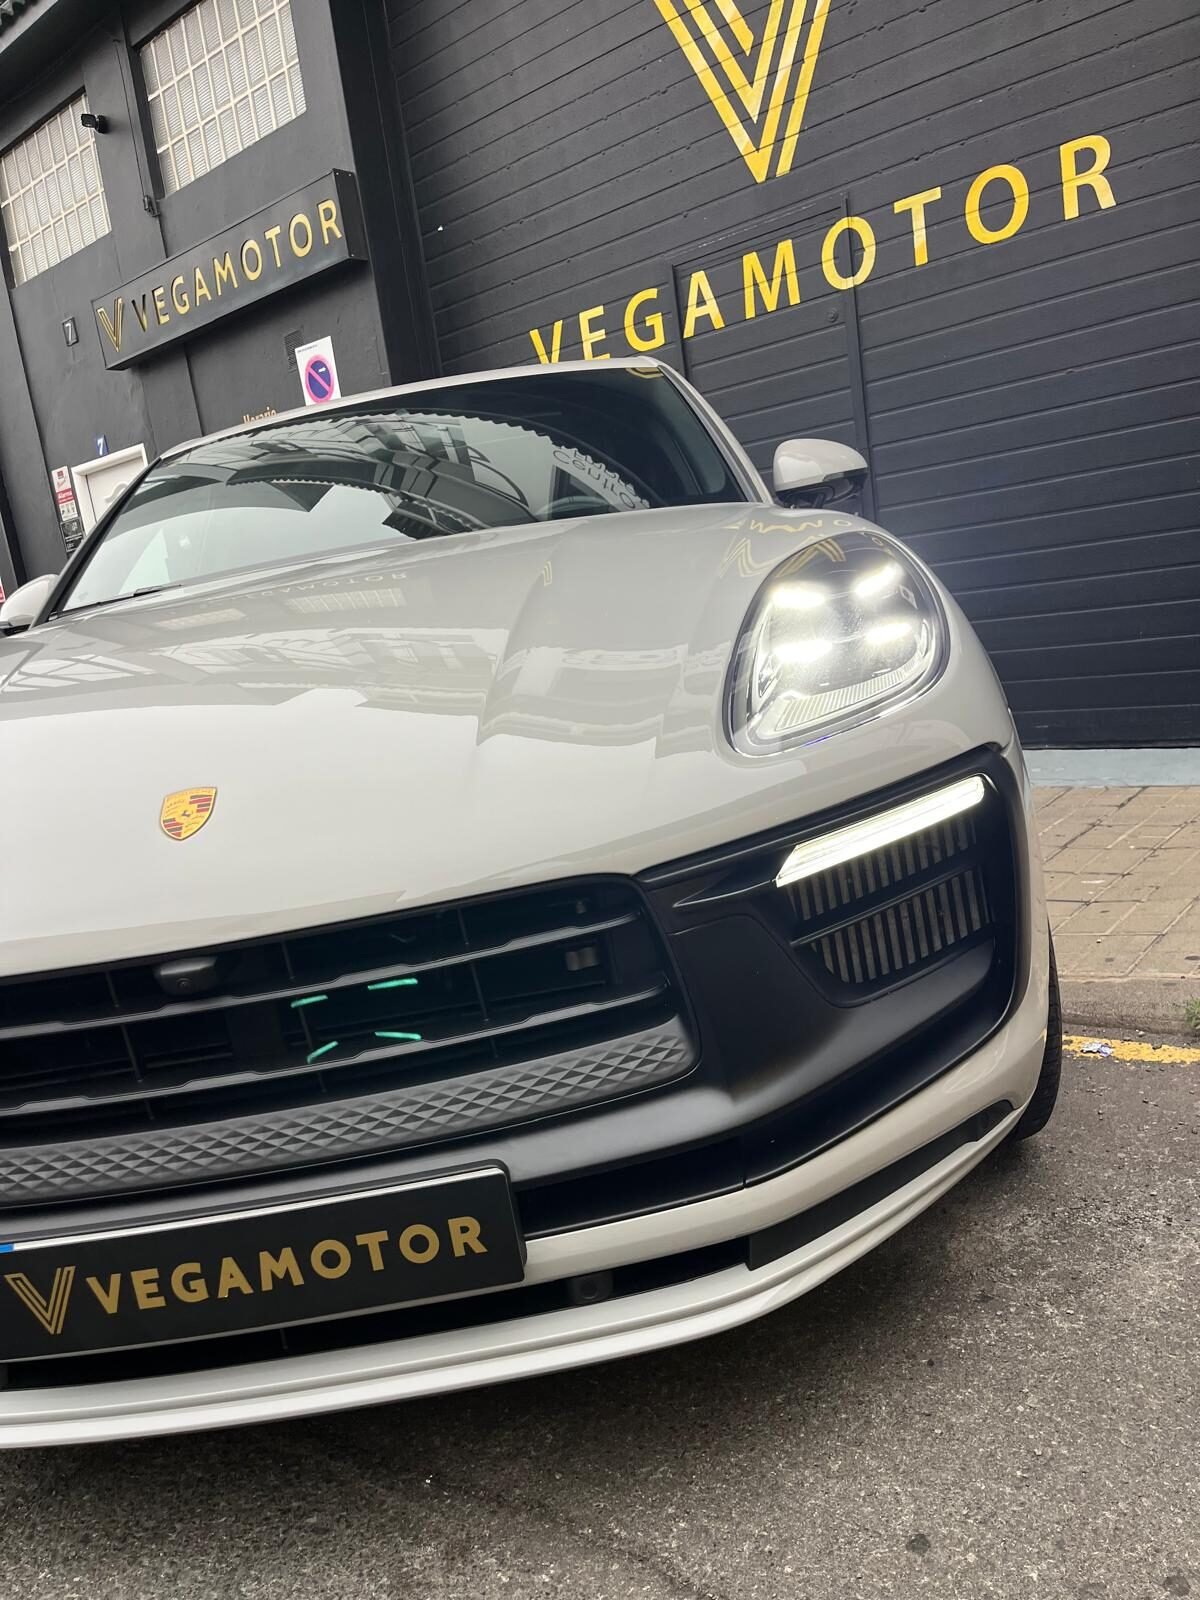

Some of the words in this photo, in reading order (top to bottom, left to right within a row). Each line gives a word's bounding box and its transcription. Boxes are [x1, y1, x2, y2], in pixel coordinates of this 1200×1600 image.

[131, 198, 343, 332] VEGAMOTOR
[528, 134, 1117, 365] VEGAMOTOR
[97, 437, 105, 456] 7
[86, 1216, 488, 1315] VEGAMOTOR
